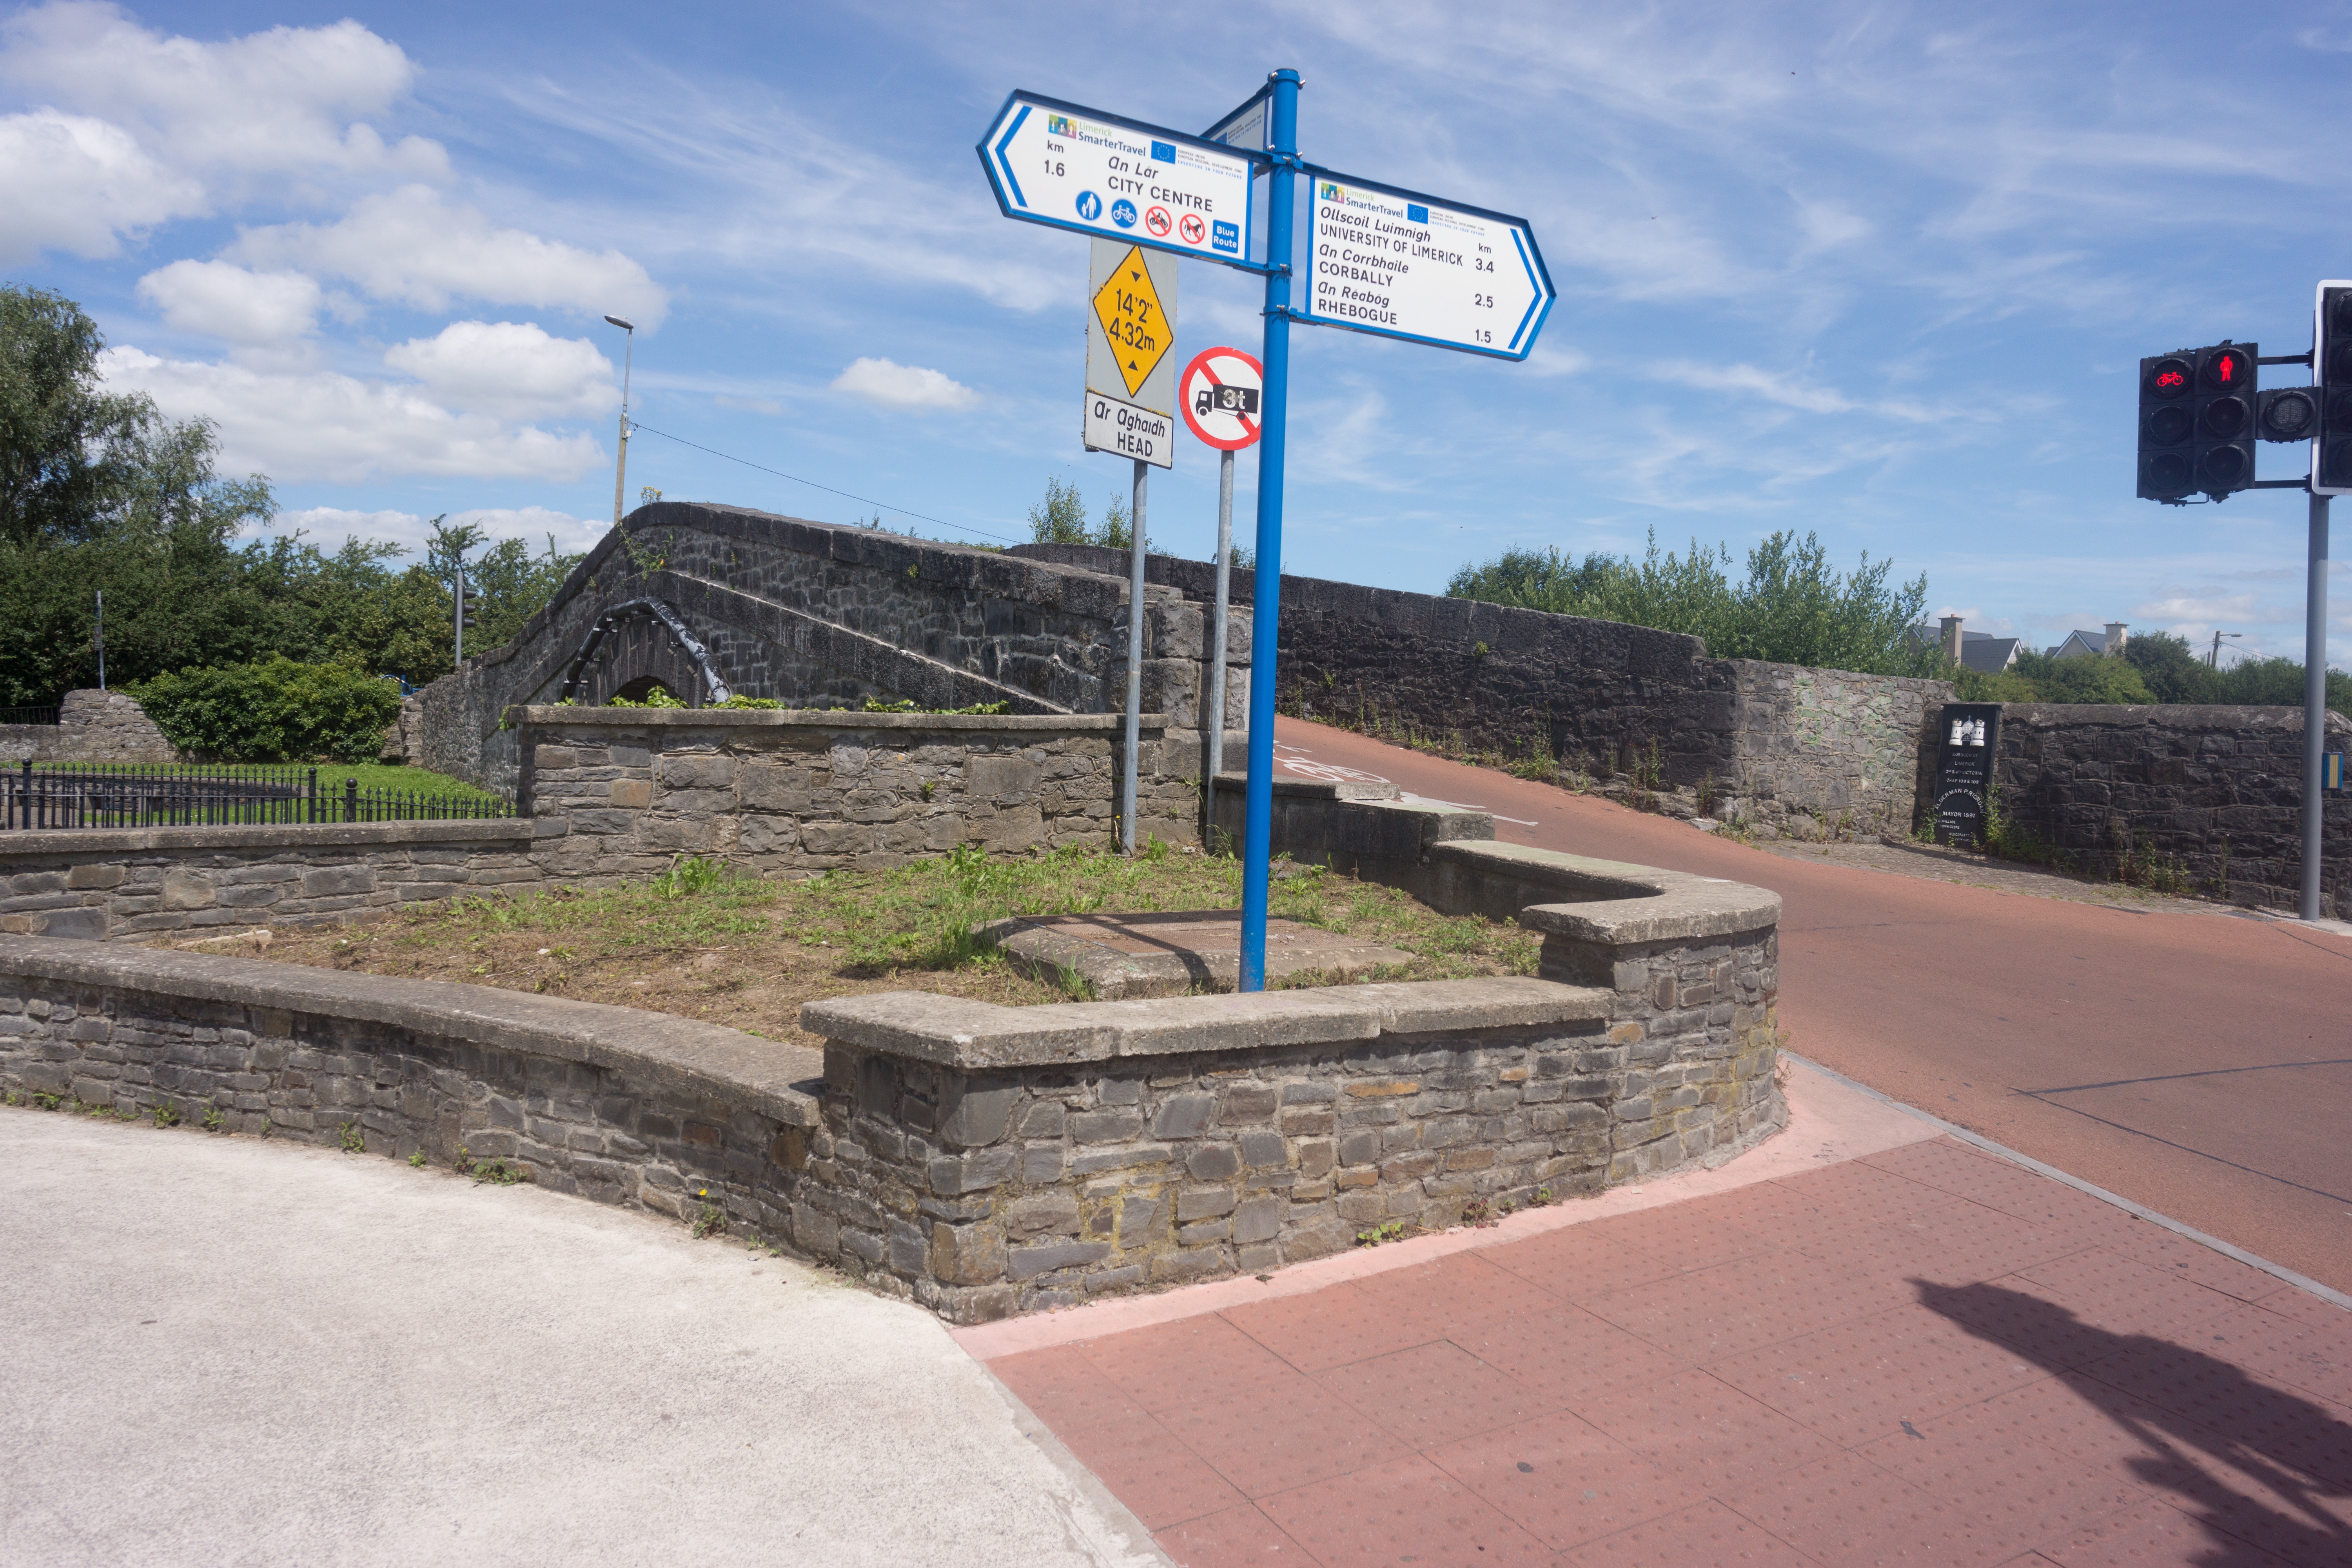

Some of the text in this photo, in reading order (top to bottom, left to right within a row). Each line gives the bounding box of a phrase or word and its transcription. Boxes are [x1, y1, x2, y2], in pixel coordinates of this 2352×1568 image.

[1079, 122, 1112, 137] Limerick
[1047, 140, 1064, 153] km
[1078, 132, 1146, 156] SmarterTravel
[1044, 159, 1065, 177] 1.6
[1135, 162, 1159, 179] Lár
[1178, 160, 1203, 169] INVESTING
[1212, 163, 1233, 171] DEVELOPMENT
[1108, 176, 1213, 212] CITY CENTRE
[1347, 188, 1374, 202] Limerick
[1346, 197, 1403, 218] SmarterTravel
[1216, 225, 1235, 237] Blue
[1321, 207, 1431, 243] Ollscoil Luimnigh
[1430, 220, 1451, 229] INVESTING
[1213, 235, 1237, 248] Route
[1320, 223, 1463, 267] UNIVERSITY OF LIMERICK
[1479, 243, 1491, 254] km
[1343, 249, 1409, 274] Corrbhaile
[1475, 258, 1494, 273] 3.4
[1319, 261, 1393, 287] CORBALLY
[1341, 286, 1390, 308] Réabóg
[1475, 293, 1494, 308] 2.5
[1318, 298, 1397, 325] RHEBOGUE
[1109, 317, 1155, 352] 4.32m
[1475, 329, 1491, 343] 1.5
[1118, 432, 1153, 457] HEAD
[1935, 788, 1962, 810] ALDERMAN
